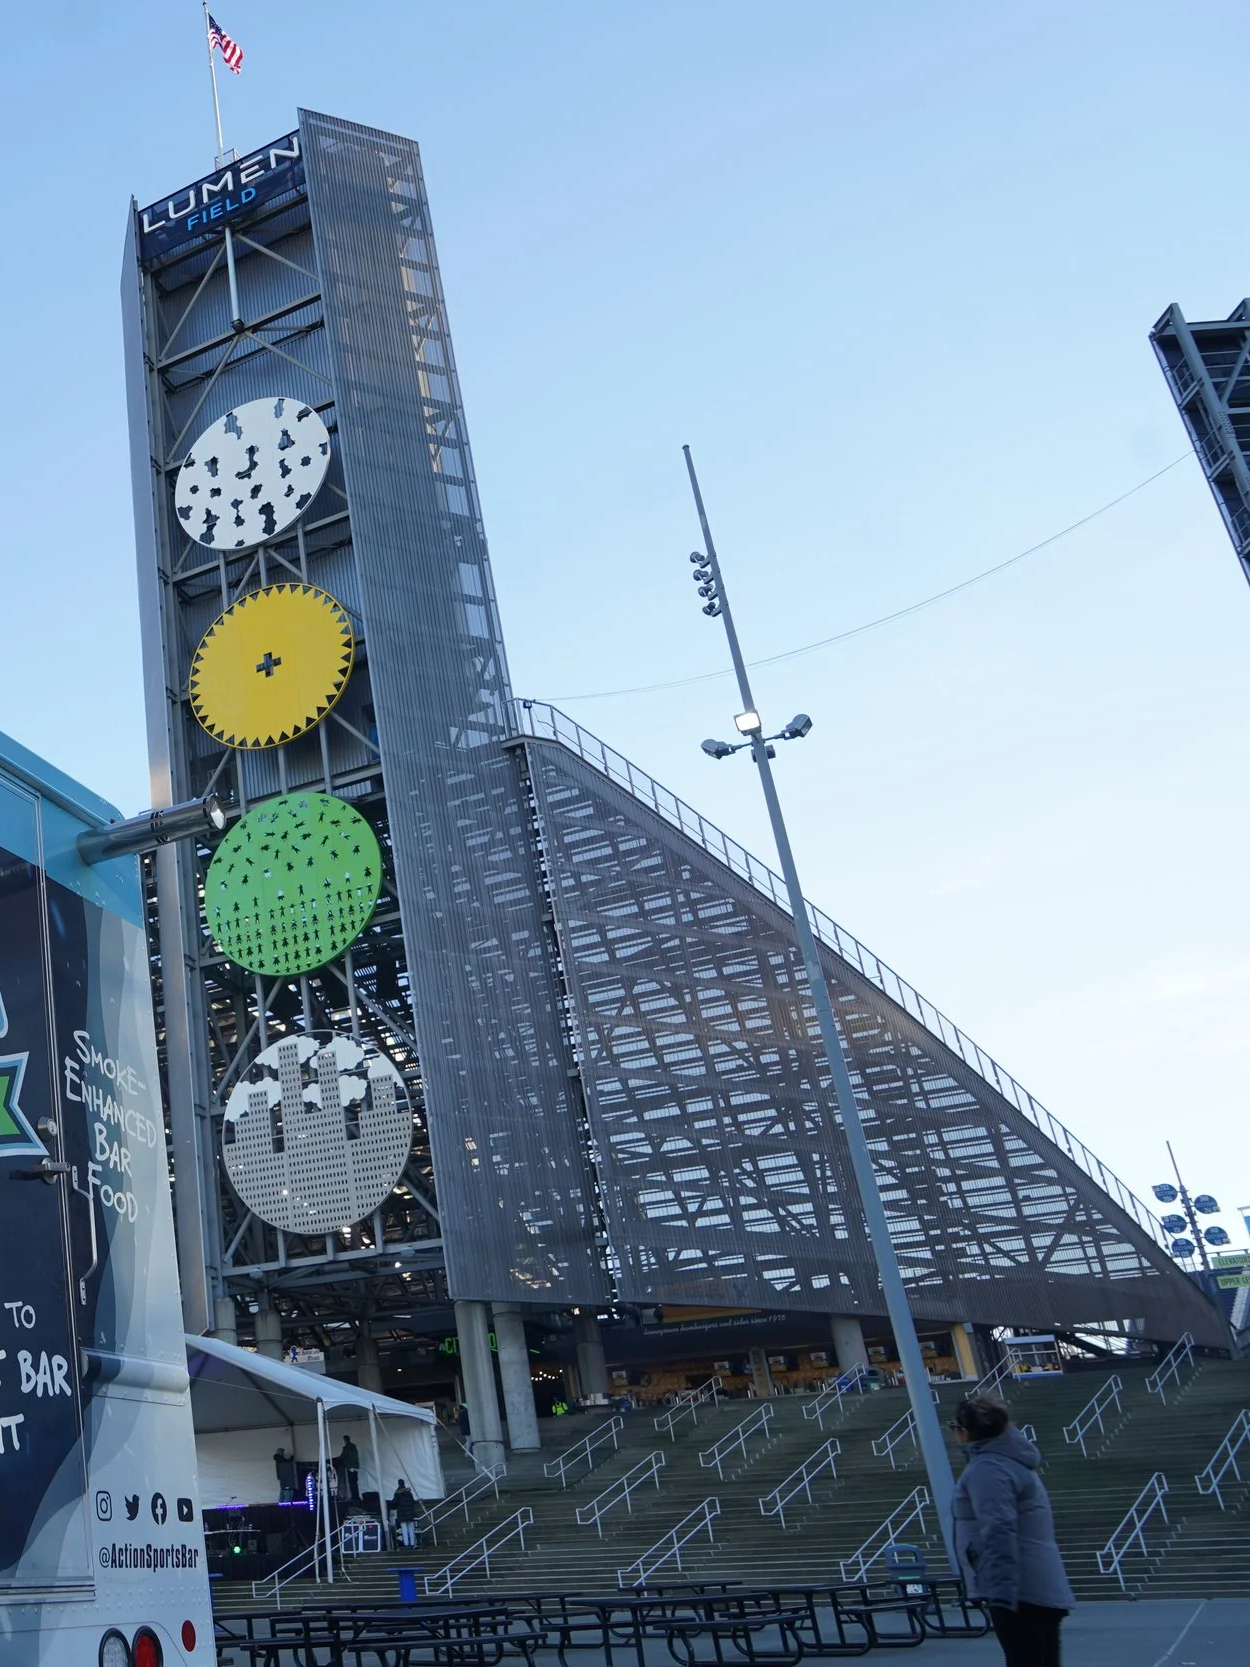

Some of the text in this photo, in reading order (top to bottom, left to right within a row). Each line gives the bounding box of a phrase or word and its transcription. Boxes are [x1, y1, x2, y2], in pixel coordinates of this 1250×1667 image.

[143, 136, 300, 235] LUMEN
[187, 187, 257, 232] FIELD
[73, 1030, 147, 1096] SMOKE-
[64, 1056, 157, 1149] ENHANCED
[94, 1122, 133, 1178] BAR
[87, 1161, 139, 1223] FOOD
[1220, 1276, 1240, 1287] UPPER
[4, 1300, 36, 1329] TO
[17, 1350, 72, 1398] BAR
[99, 1543, 199, 1573] @ActionSportsBar
